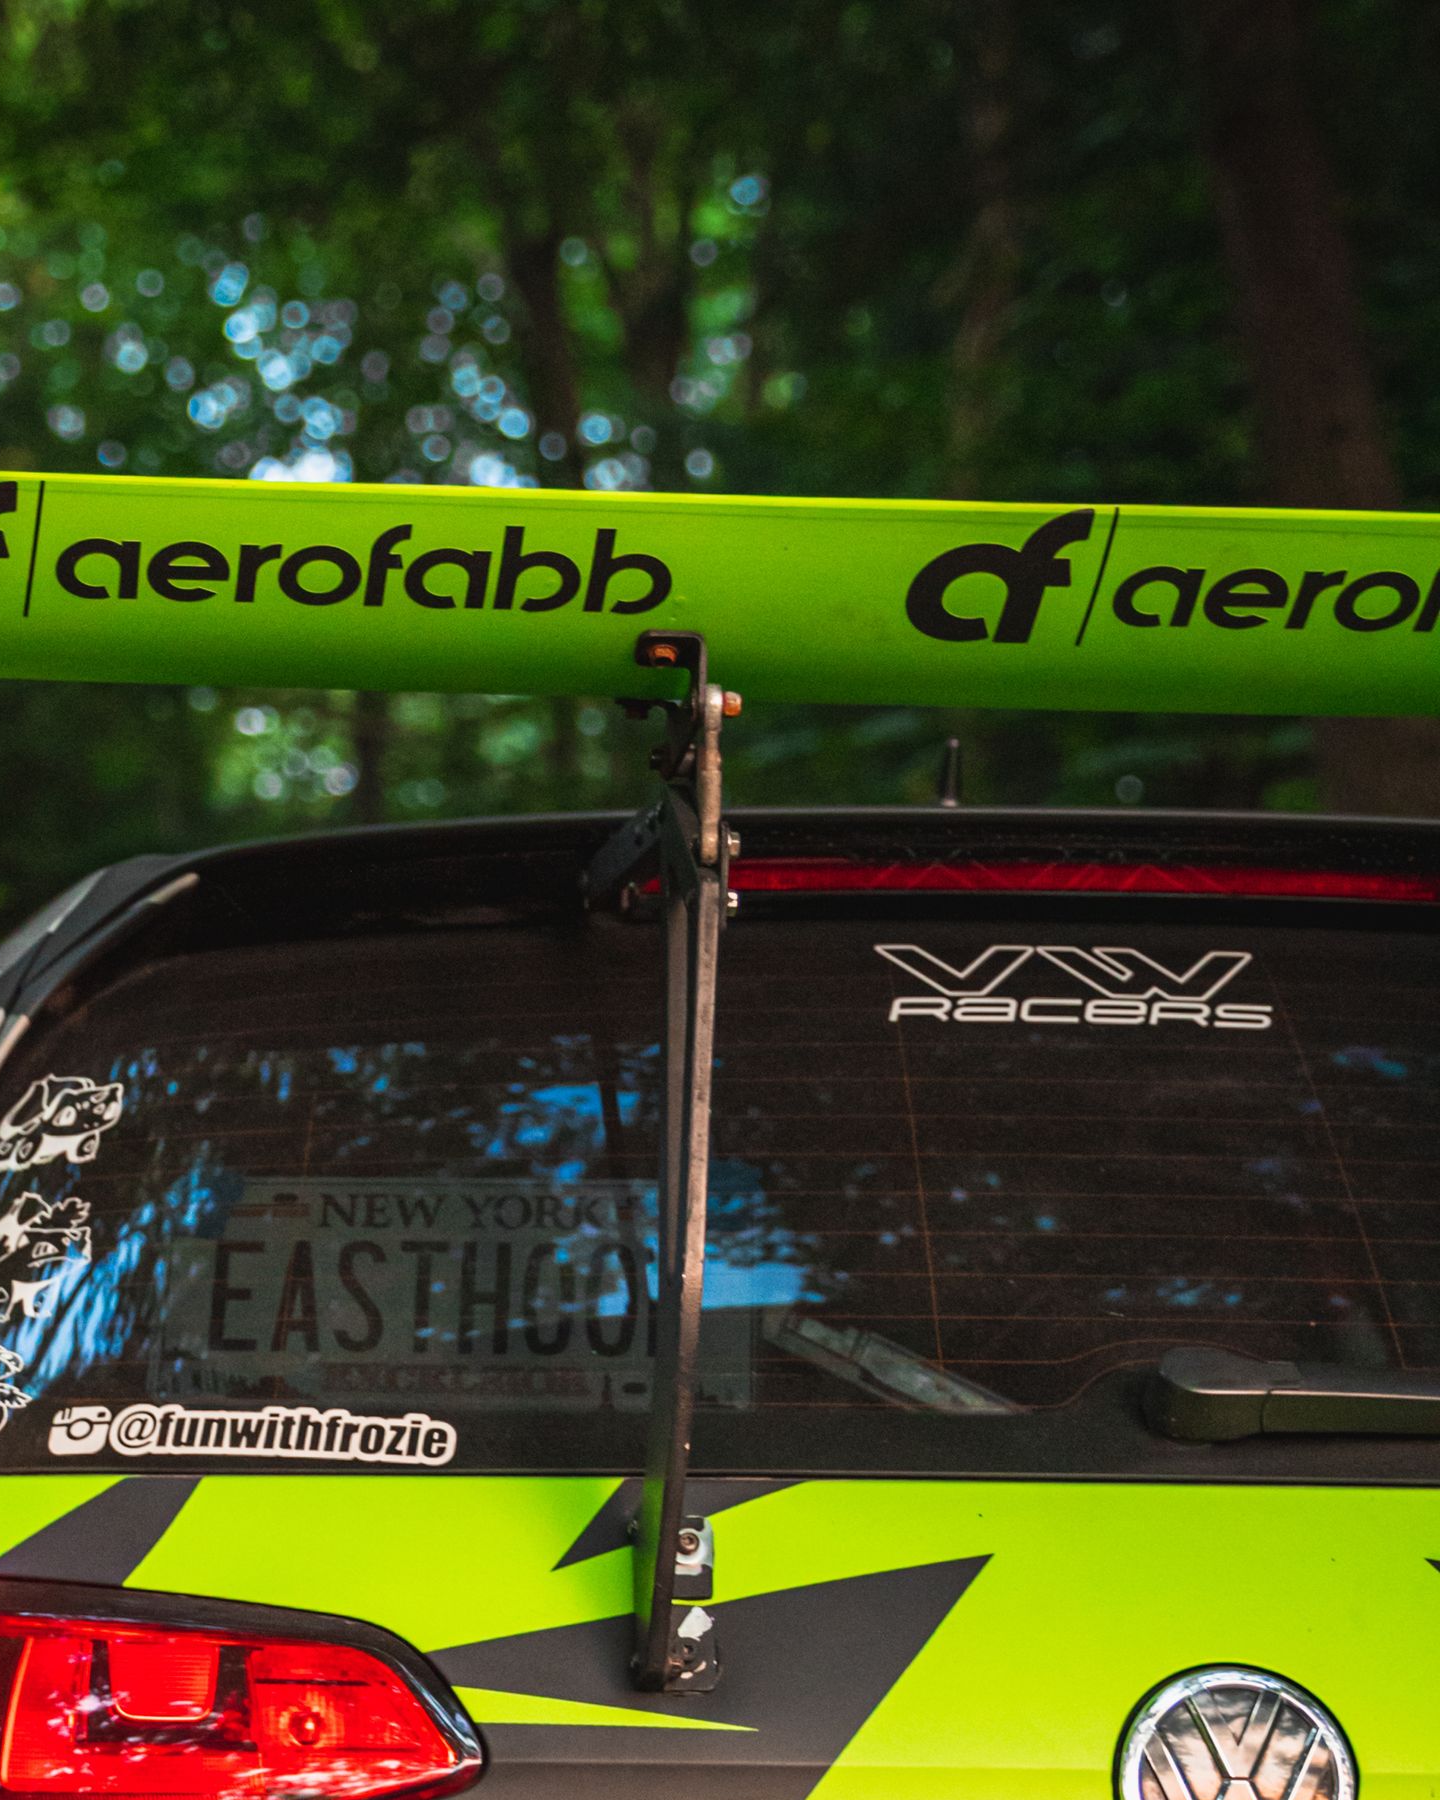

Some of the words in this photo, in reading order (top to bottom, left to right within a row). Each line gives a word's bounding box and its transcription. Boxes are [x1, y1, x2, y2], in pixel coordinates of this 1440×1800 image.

[54, 523, 673, 615] aerofabb
[318, 1192, 444, 1229] NEW
[459, 1193, 606, 1230] YORK
[208, 1240, 658, 1358] EASTHOO
[115, 1410, 450, 1459] @funwithfrozie
